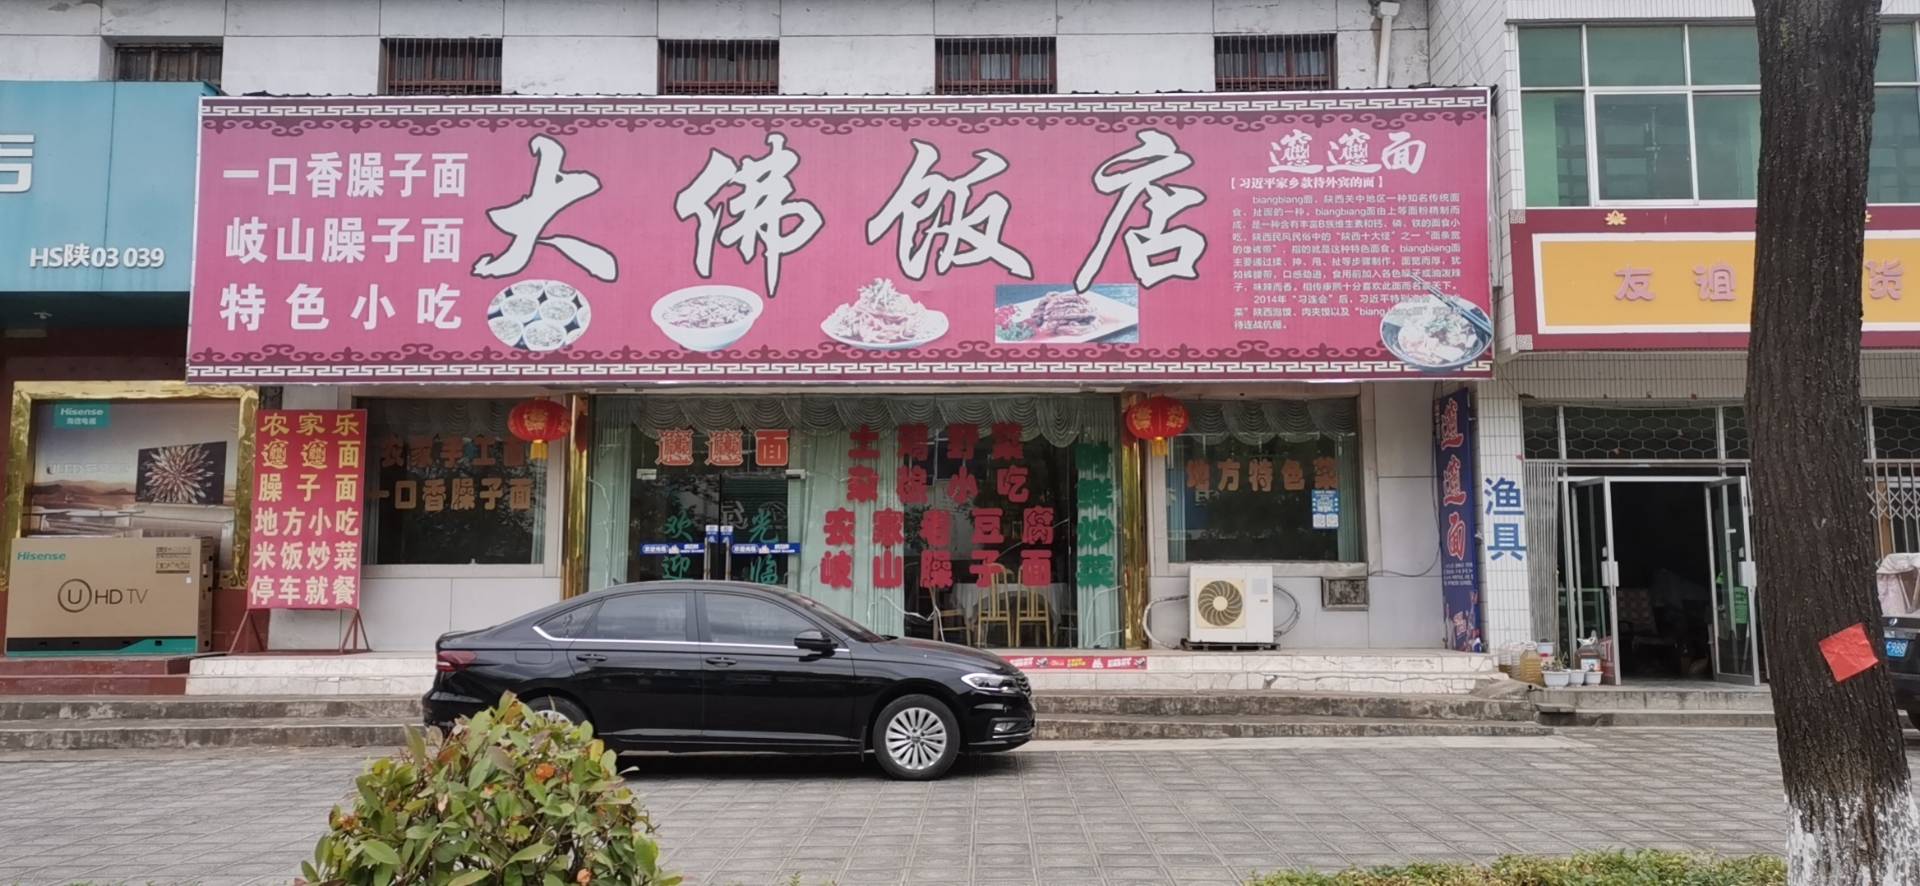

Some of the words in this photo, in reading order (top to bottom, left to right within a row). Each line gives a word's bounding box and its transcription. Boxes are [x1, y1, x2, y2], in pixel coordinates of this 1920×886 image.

[223, 153, 468, 198] 一口香臊子面
[472, 129, 1205, 297] 大佛饭店
[29, 242, 119, 268] HS陕03
[123, 247, 165, 268] 039
[225, 217, 465, 264] 岐山臊子面
[220, 284, 462, 331] 特色小吃
[60, 407, 104, 416] Hisense
[260, 412, 359, 436] 农家乐
[258, 473, 358, 502] 臊子面
[367, 477, 536, 512] 一口香臊子面
[254, 506, 359, 537] 地方小吃
[1485, 476, 1527, 562] 渔具
[17, 551, 67, 561] Hisense
[252, 540, 358, 571] 米饭炒菜
[662, 510, 693, 580] 欢迎
[749, 509, 780, 584] 光临
[820, 548, 1053, 589] 岐山臊子面
[126, 588, 149, 605] TV
[250, 574, 357, 606] 停车就餐
